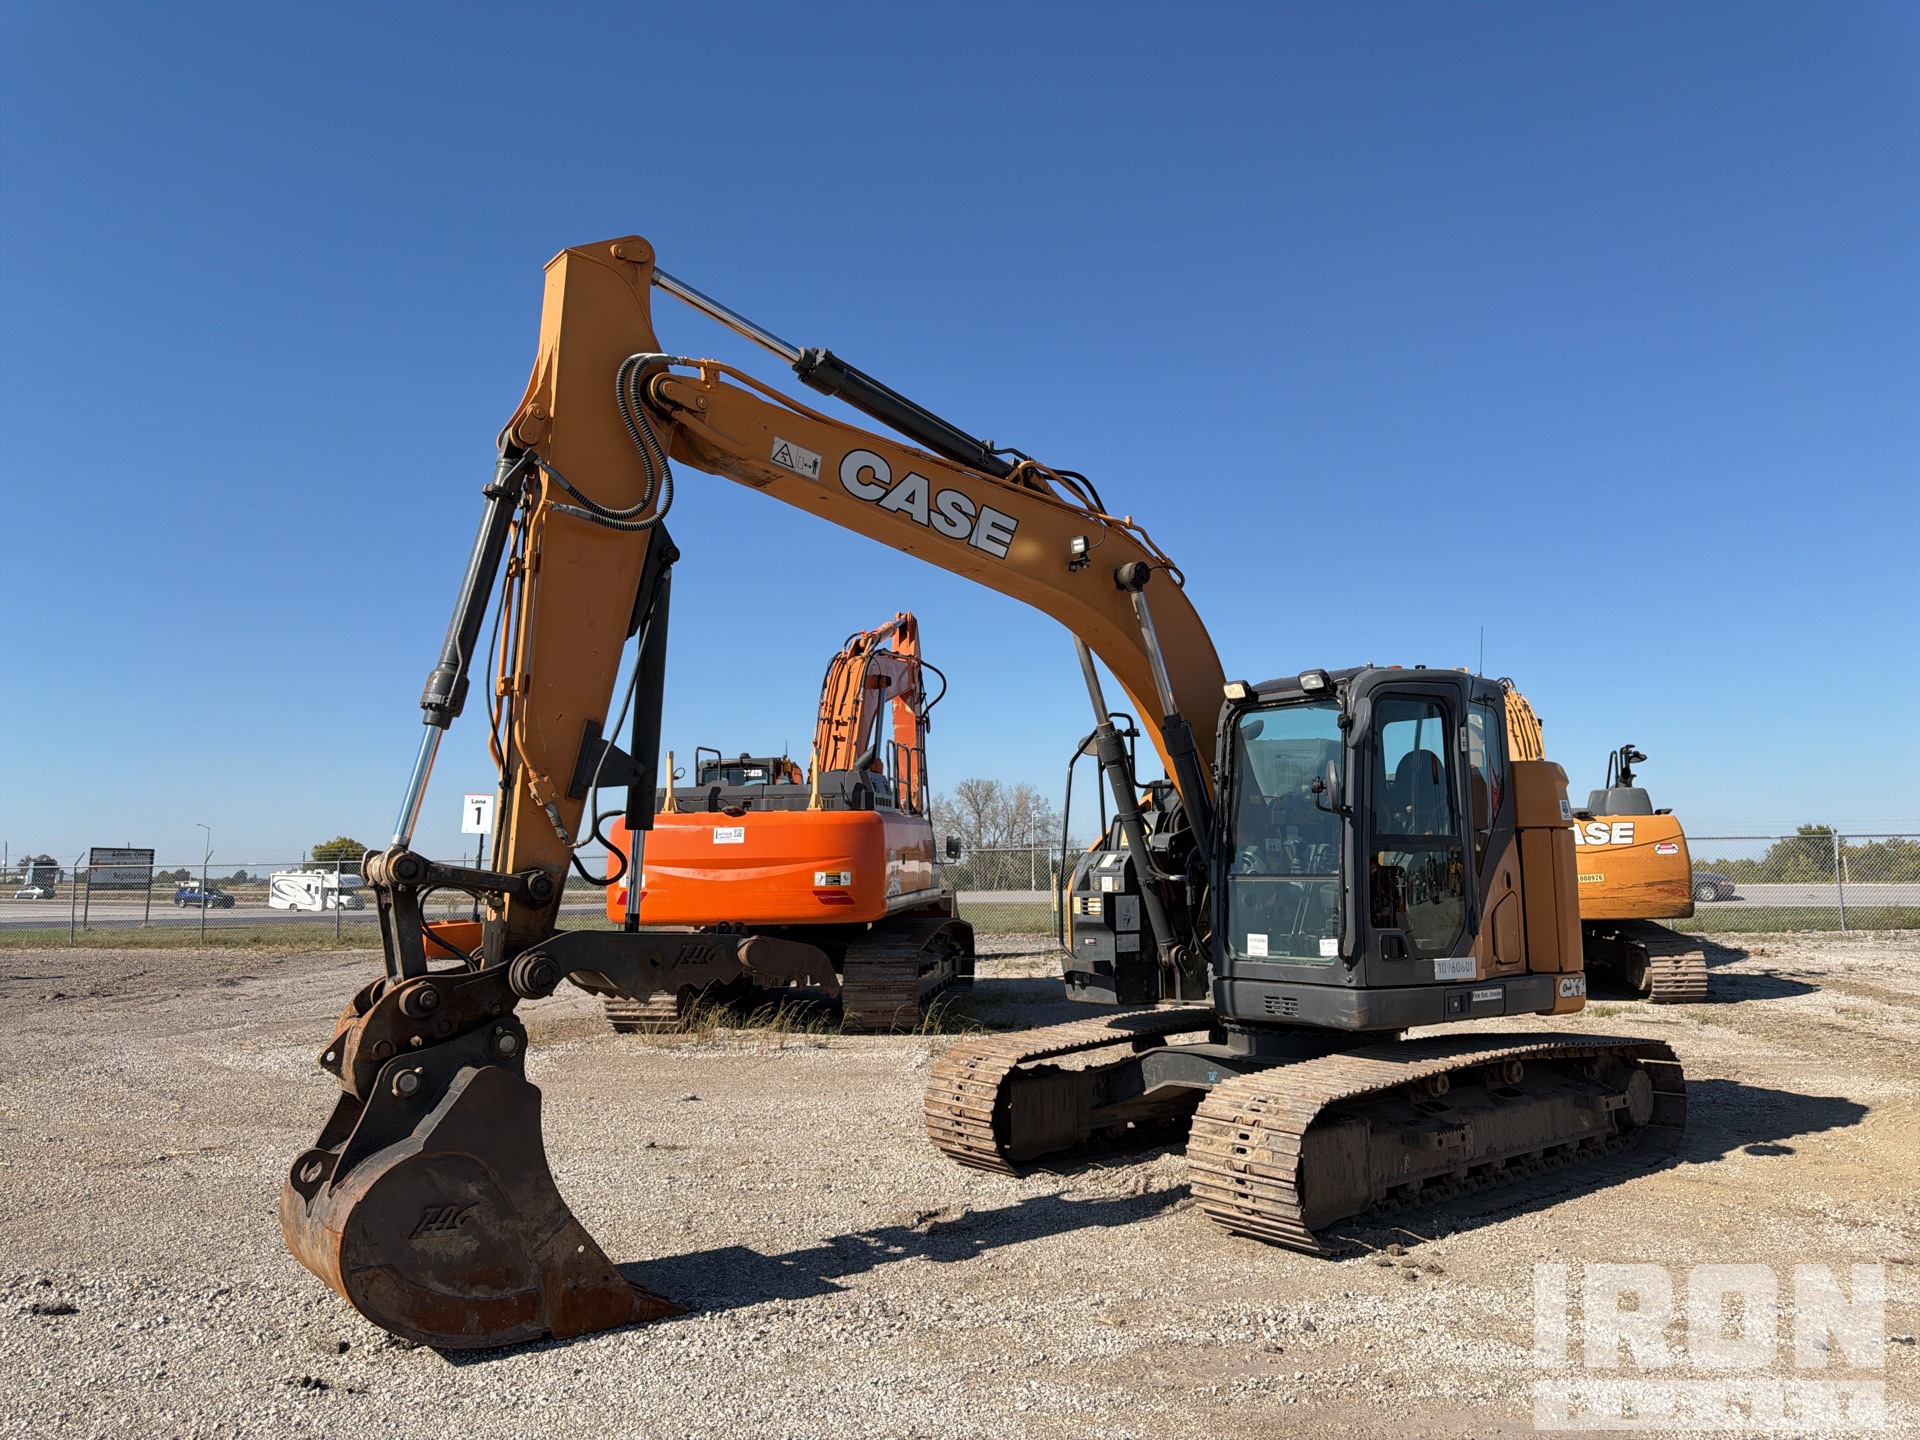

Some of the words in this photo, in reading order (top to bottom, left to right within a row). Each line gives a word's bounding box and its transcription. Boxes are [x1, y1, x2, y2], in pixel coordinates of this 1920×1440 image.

[838, 448, 1020, 560] CASE
[475, 806, 482, 826] 1
[1568, 822, 1635, 846] ASE
[112, 850, 131, 858] Admin
